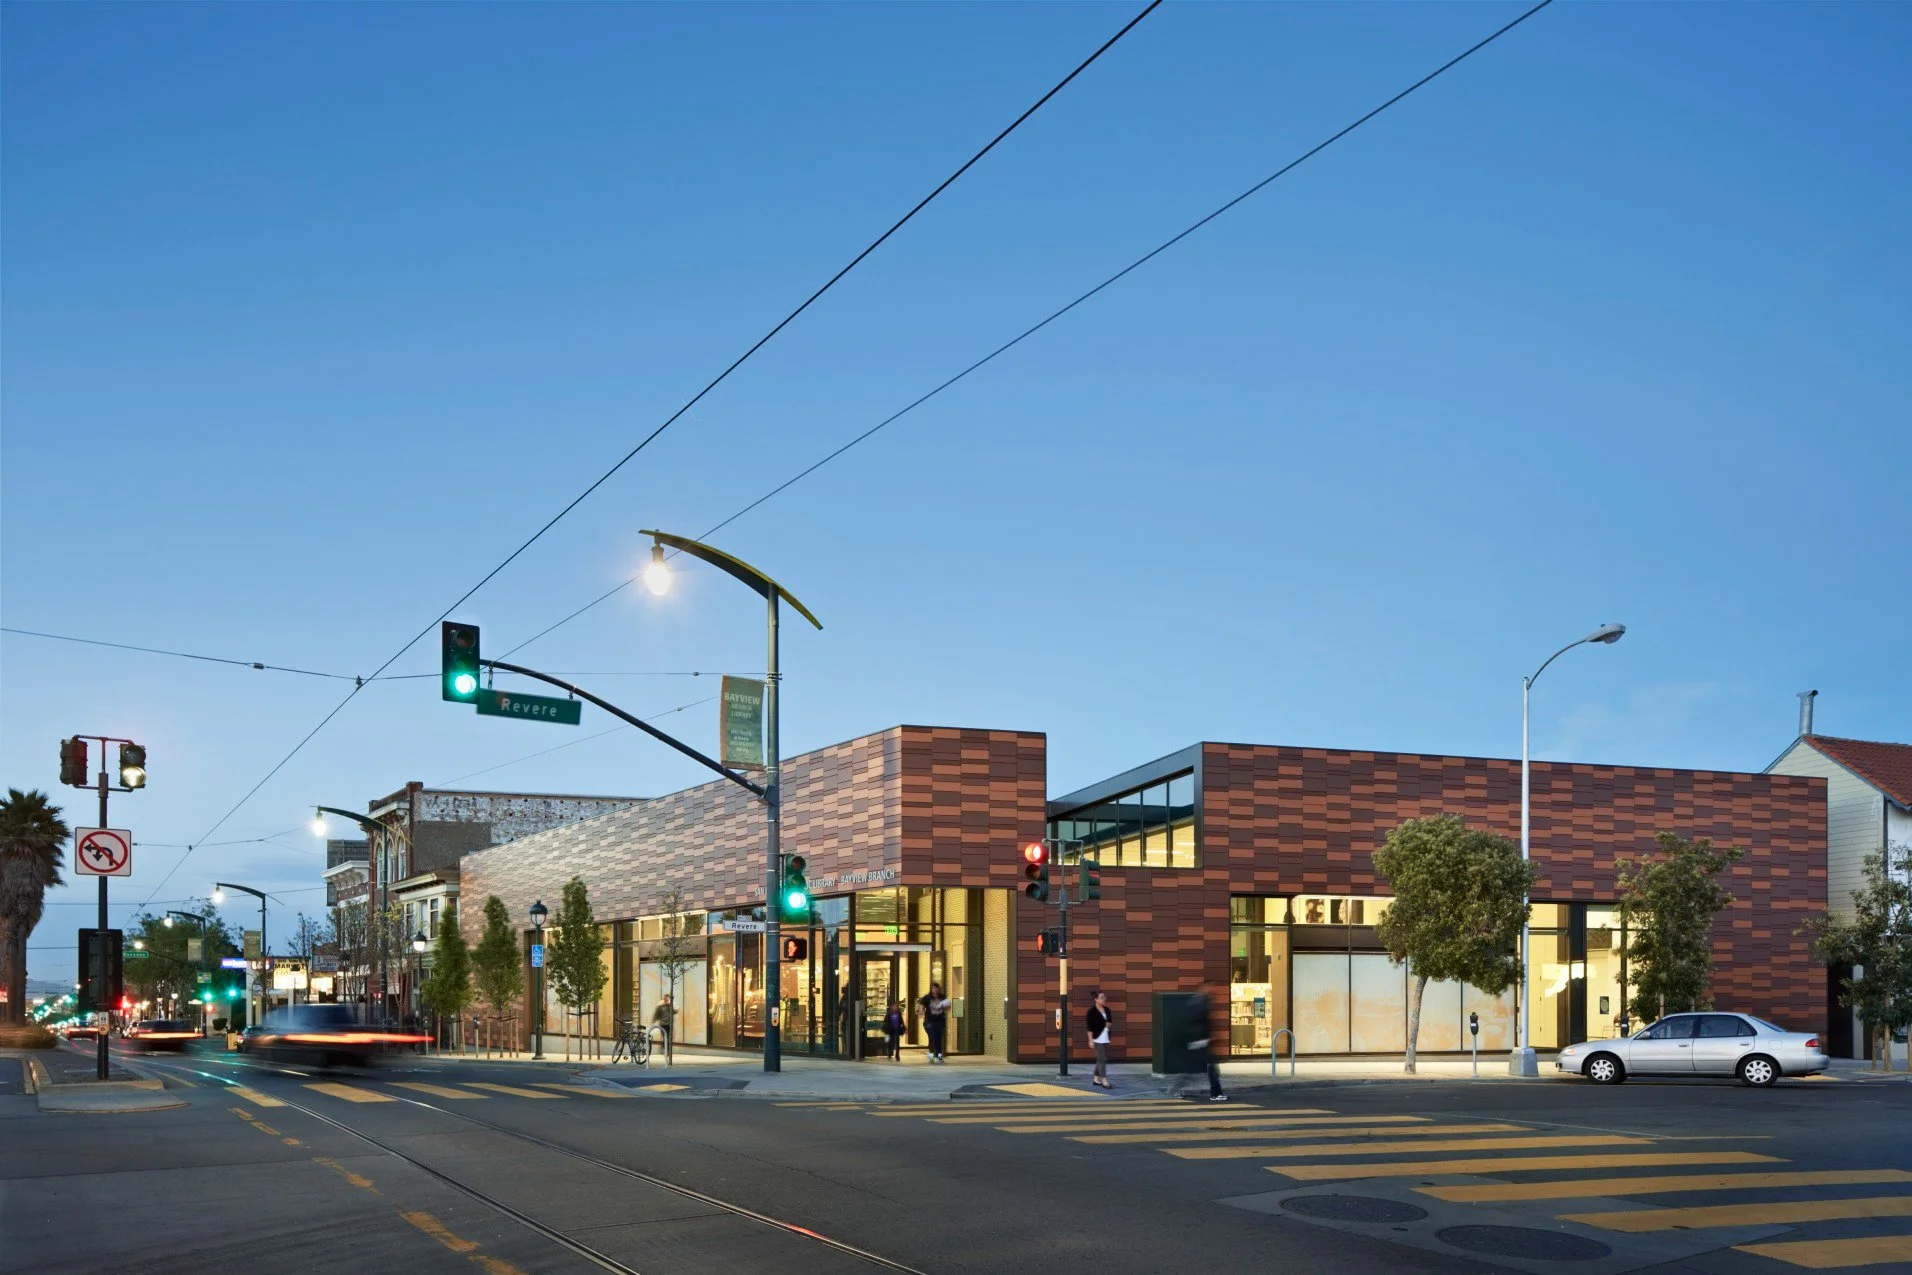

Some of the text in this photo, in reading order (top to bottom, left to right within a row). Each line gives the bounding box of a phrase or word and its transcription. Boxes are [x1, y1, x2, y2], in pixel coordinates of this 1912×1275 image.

[724, 692, 760, 705] BAYVIEW
[501, 698, 557, 717] Revere
[814, 876, 836, 888] LIBRARY
[841, 872, 868, 884] BAYVIEW
[868, 869, 895, 881] BRANCH
[731, 922, 758, 930] Revere
